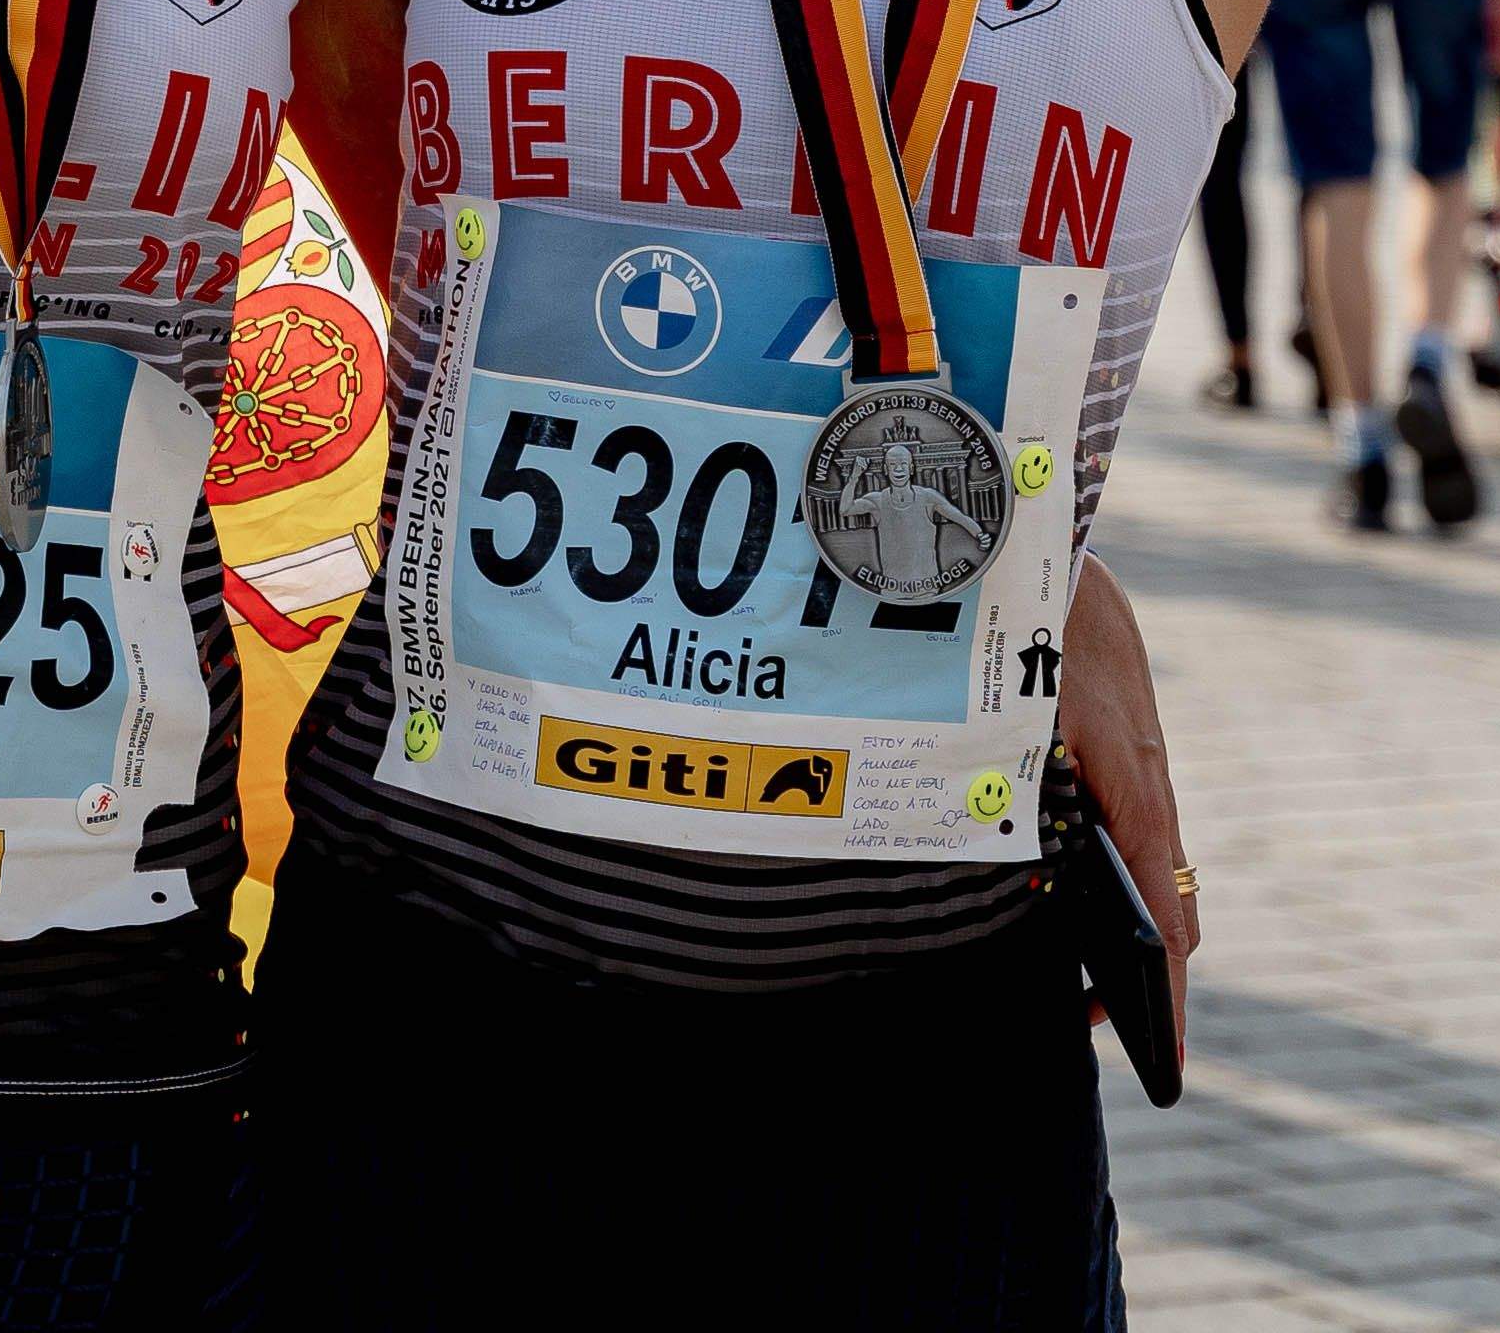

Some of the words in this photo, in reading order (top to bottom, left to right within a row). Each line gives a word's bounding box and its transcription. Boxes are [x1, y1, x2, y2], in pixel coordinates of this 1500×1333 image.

[408, 50, 1132, 268] BERIN
[118, 235, 239, 304] 202
[615, 252, 707, 292] BMW
[452, 368, 461, 403] WORLD
[459, 306, 473, 364] MARATHON
[472, 261, 484, 303] MAJORS
[399, 259, 471, 590] BERLIN-MARATHON
[815, 400, 877, 482] WELTREKORD
[879, 395, 926, 410] 2:01:39
[928, 401, 973, 440] BERLIN
[970, 438, 992, 470] 2018
[430, 447, 450, 519] 2021
[470, 409, 961, 633] 530
[857, 566, 898, 593] ELIUD
[900, 559, 971, 593] KIPCHOGE
[1041, 558, 1051, 602] GRAVUR
[424, 523, 445, 681] September
[398, 593, 424, 677] BMW
[988, 629, 996, 656] Alicia
[610, 623, 786, 700] Alicia
[408, 685, 425, 714] 7.
[468, 678, 475, 690] Y
[512, 693, 528, 706] NO
[472, 755, 488, 771] LO
[862, 736, 905, 749] ESTOY
[554, 736, 729, 801] Giti
[857, 776, 879, 788] NO
[86, 811, 118, 825] BERLIN
[906, 797, 915, 809] A
[844, 834, 888, 848] HASTA
[894, 836, 912, 848] EL
